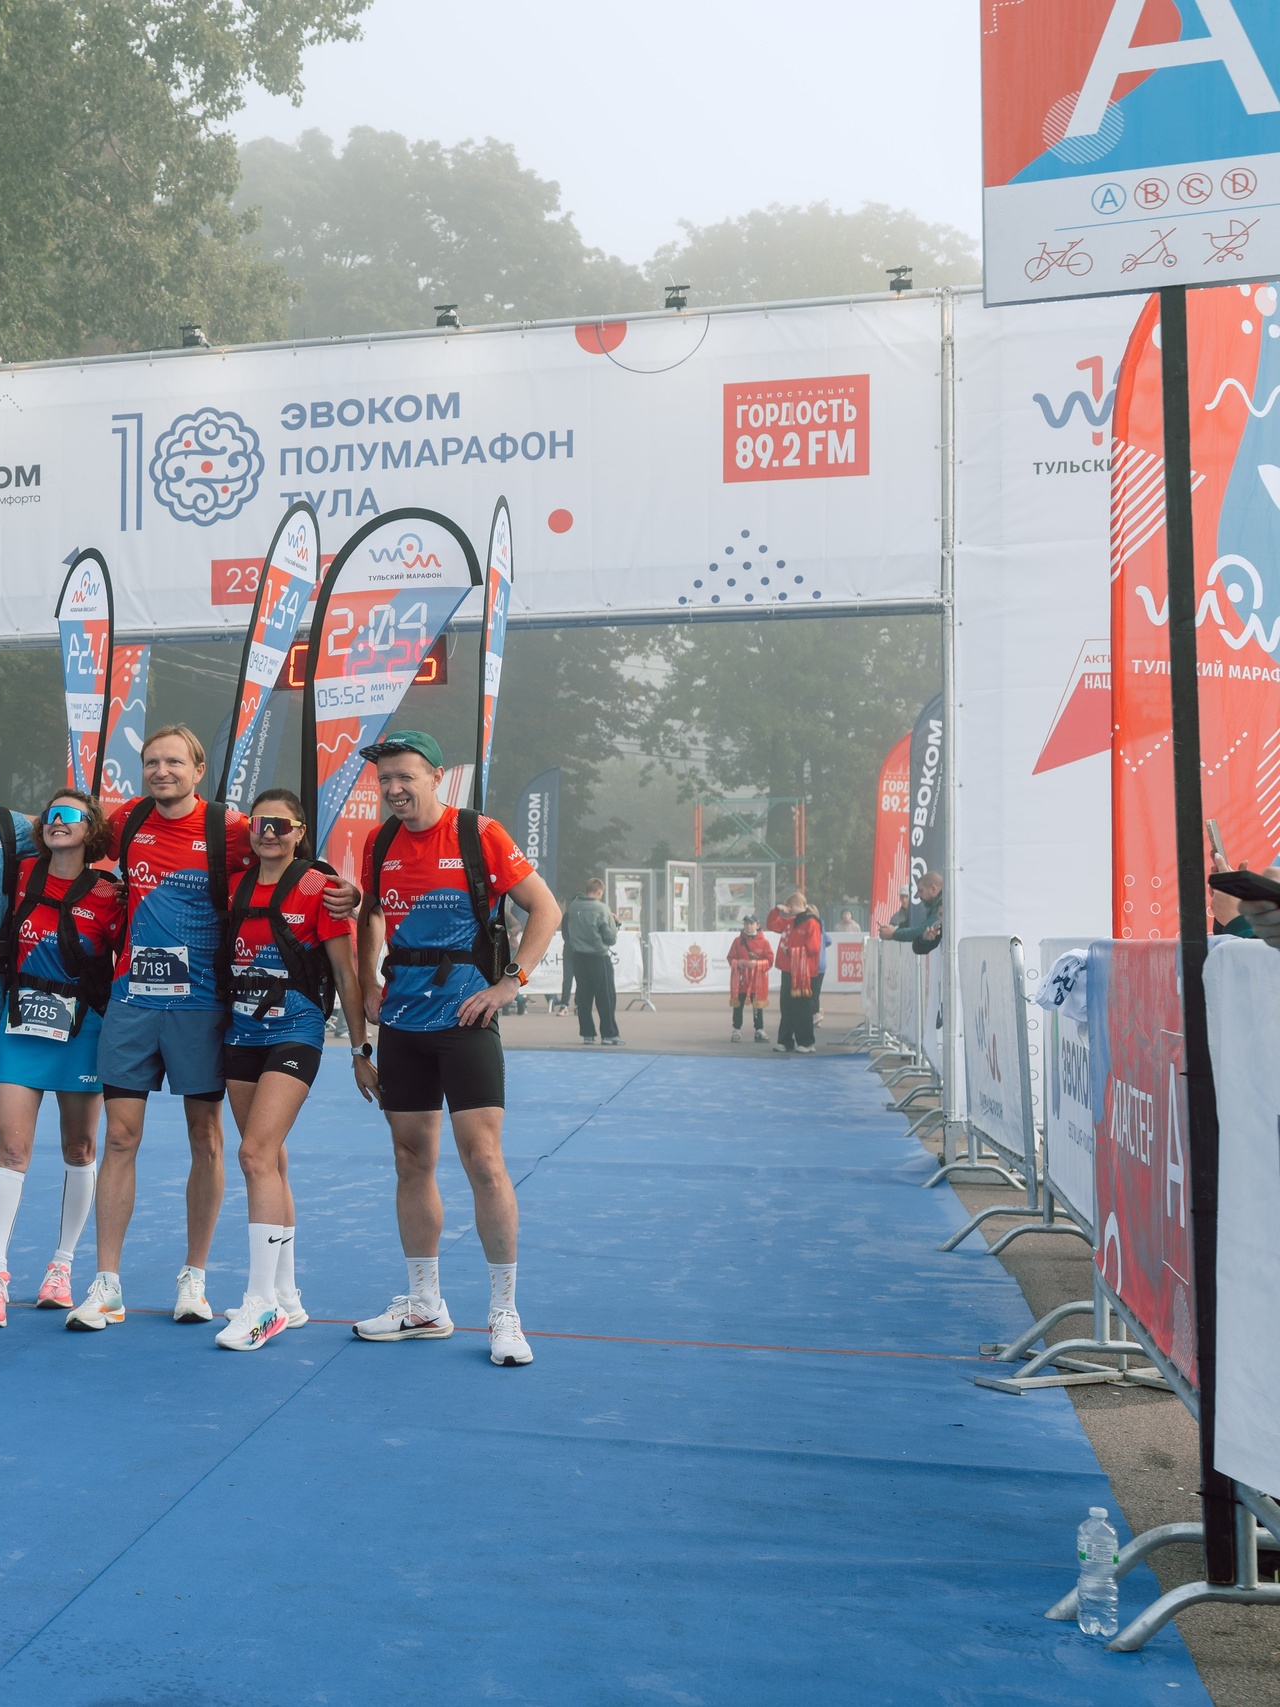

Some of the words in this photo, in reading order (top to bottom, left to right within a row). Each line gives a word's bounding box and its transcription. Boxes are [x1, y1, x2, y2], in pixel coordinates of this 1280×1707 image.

[1099, 188, 1118, 209] A
[1144, 183, 1160, 203] B
[1186, 178, 1203, 198] C
[1232, 173, 1249, 193] D
[736, 387, 855, 400] РАДИОСТАНЦИЯ
[280, 391, 461, 431] ЭВОКОМ
[736, 398, 857, 429] ГОРДОСТЬ
[280, 429, 574, 476] ПОЛУМАРАФОН
[735, 431, 801, 470] 89.2
[808, 428, 855, 466] FM
[280, 487, 381, 518] ТУЛА
[368, 573, 405, 582] ТУЛЬСКИЙ
[406, 571, 442, 580] МАРАФОН
[1132, 659, 1223, 679] ТУЛКИЙ
[317, 685, 366, 708] 05:52
[370, 682, 403, 693] минут
[370, 694, 384, 702] км
[247, 757, 261, 804] эволюция
[257, 710, 272, 756] комфорта
[883, 780, 910, 793] ГОРД
[911, 719, 943, 847] ЭВОКОМ
[349, 790, 378, 802] ДОСТЬ
[358, 803, 377, 820] FM
[161, 871, 208, 883] ПЕЙСМЕЙКЕР
[161, 880, 205, 890] pacemaker
[411, 893, 460, 902] ПЕЙСМЕЙКЕР
[841, 951, 860, 962] ГОРД
[141, 961, 170, 976] 7181
[24, 1003, 57, 1020] 7185
[1062, 1036, 1092, 1111] ЭВОКО
